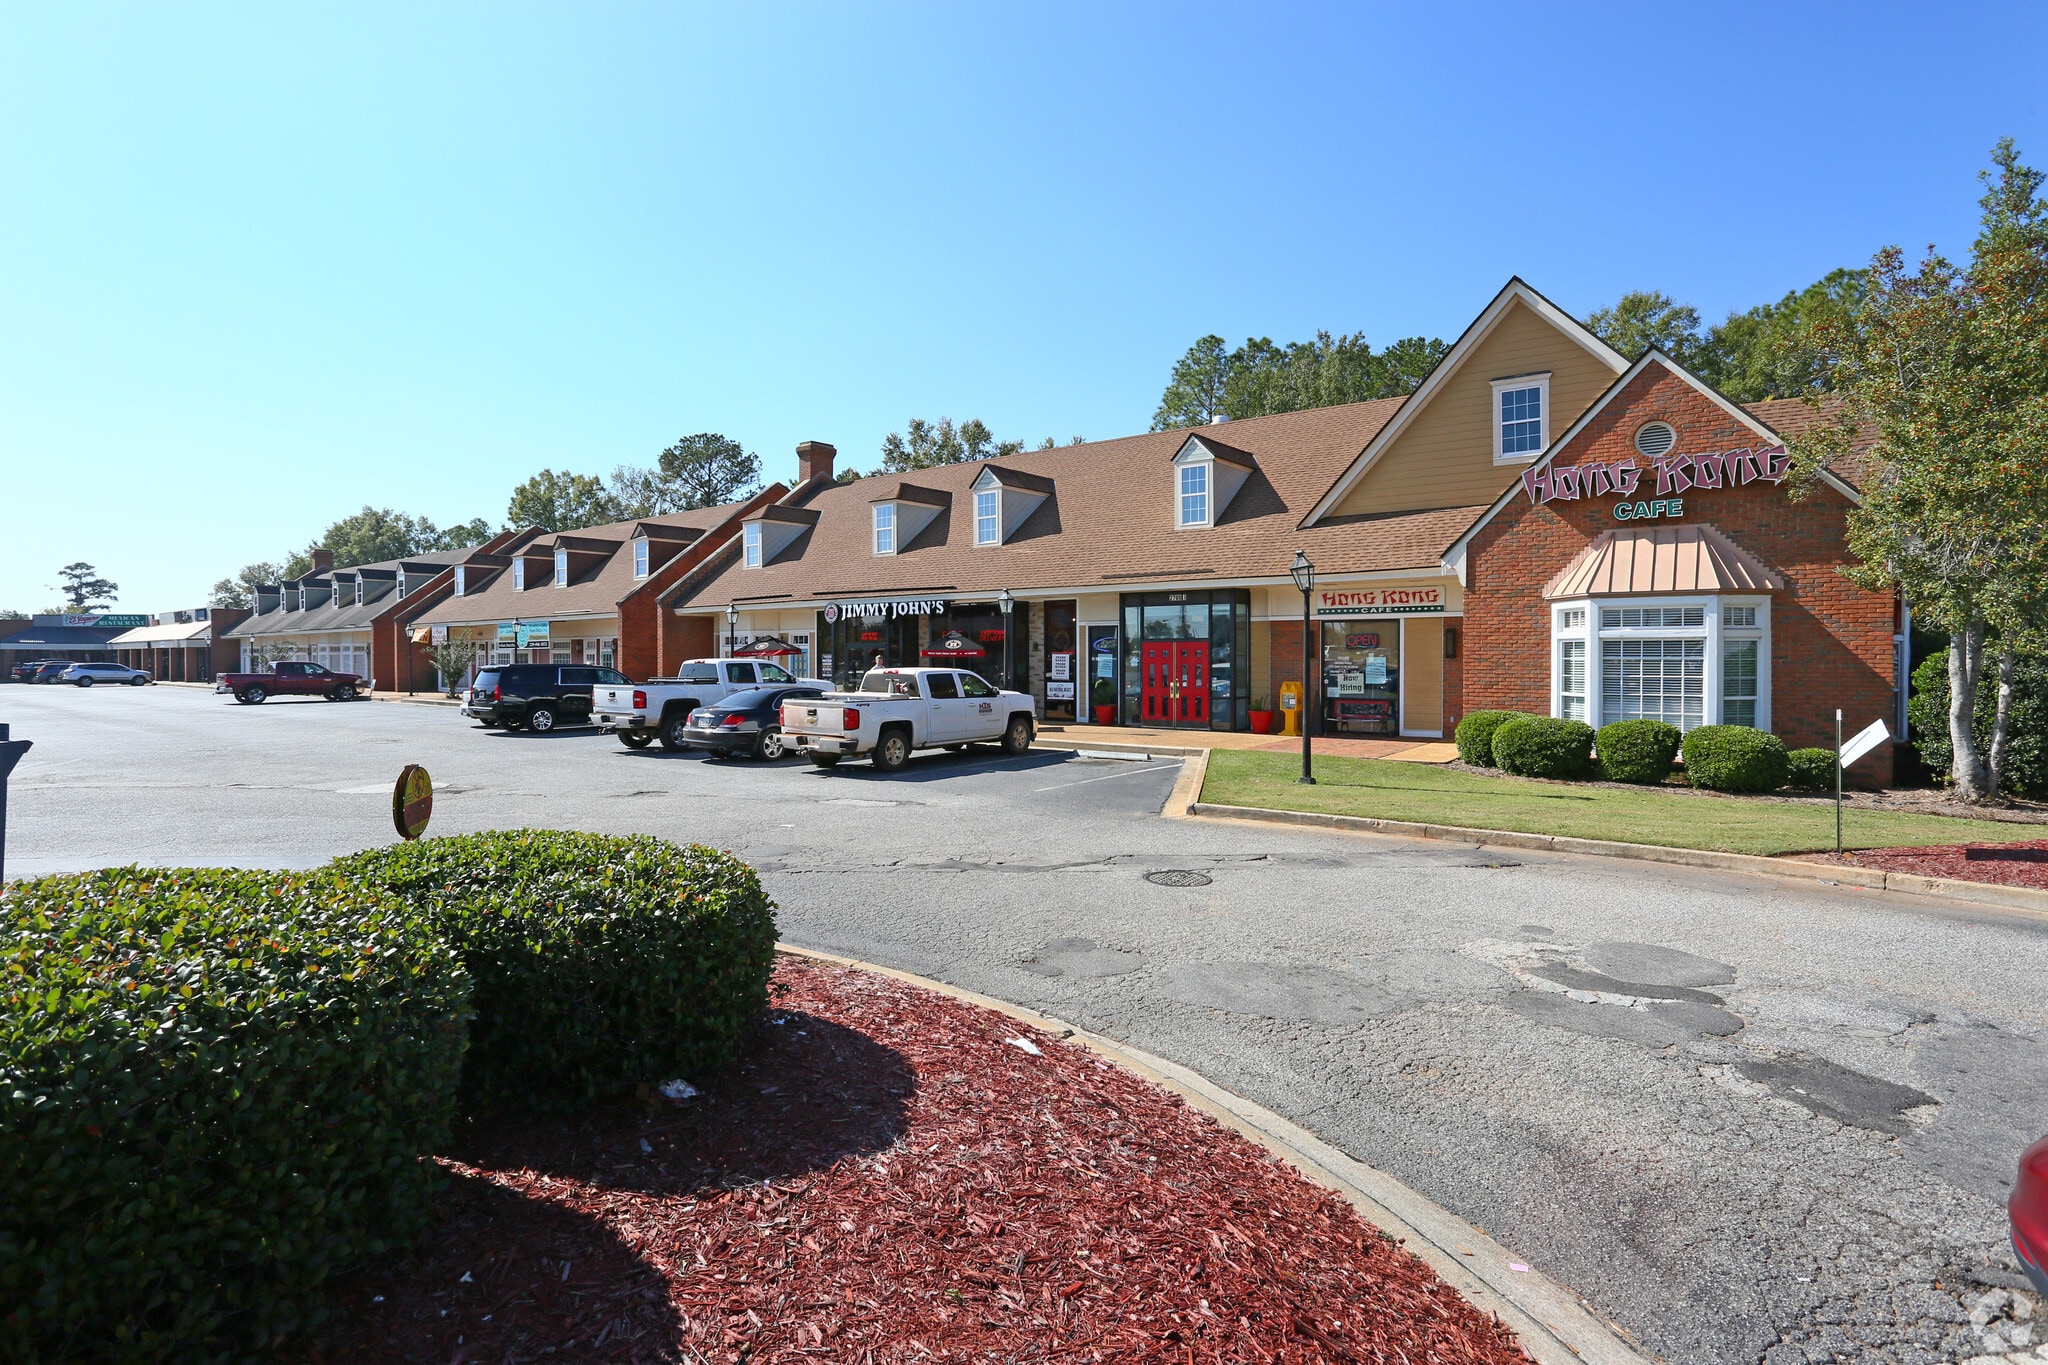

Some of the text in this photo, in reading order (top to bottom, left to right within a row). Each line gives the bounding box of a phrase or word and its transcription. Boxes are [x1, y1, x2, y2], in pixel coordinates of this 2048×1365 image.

[1521, 444, 1792, 504] HONG KONG
[1613, 498, 1684, 521] CAFE
[1321, 589, 1440, 607] HONG KONG
[840, 600, 944, 620] JIMMY JOHN'S
[1346, 634, 1377, 646] OPEN
[1343, 674, 1359, 682] Now
[1340, 684, 1362, 692] Hiring
